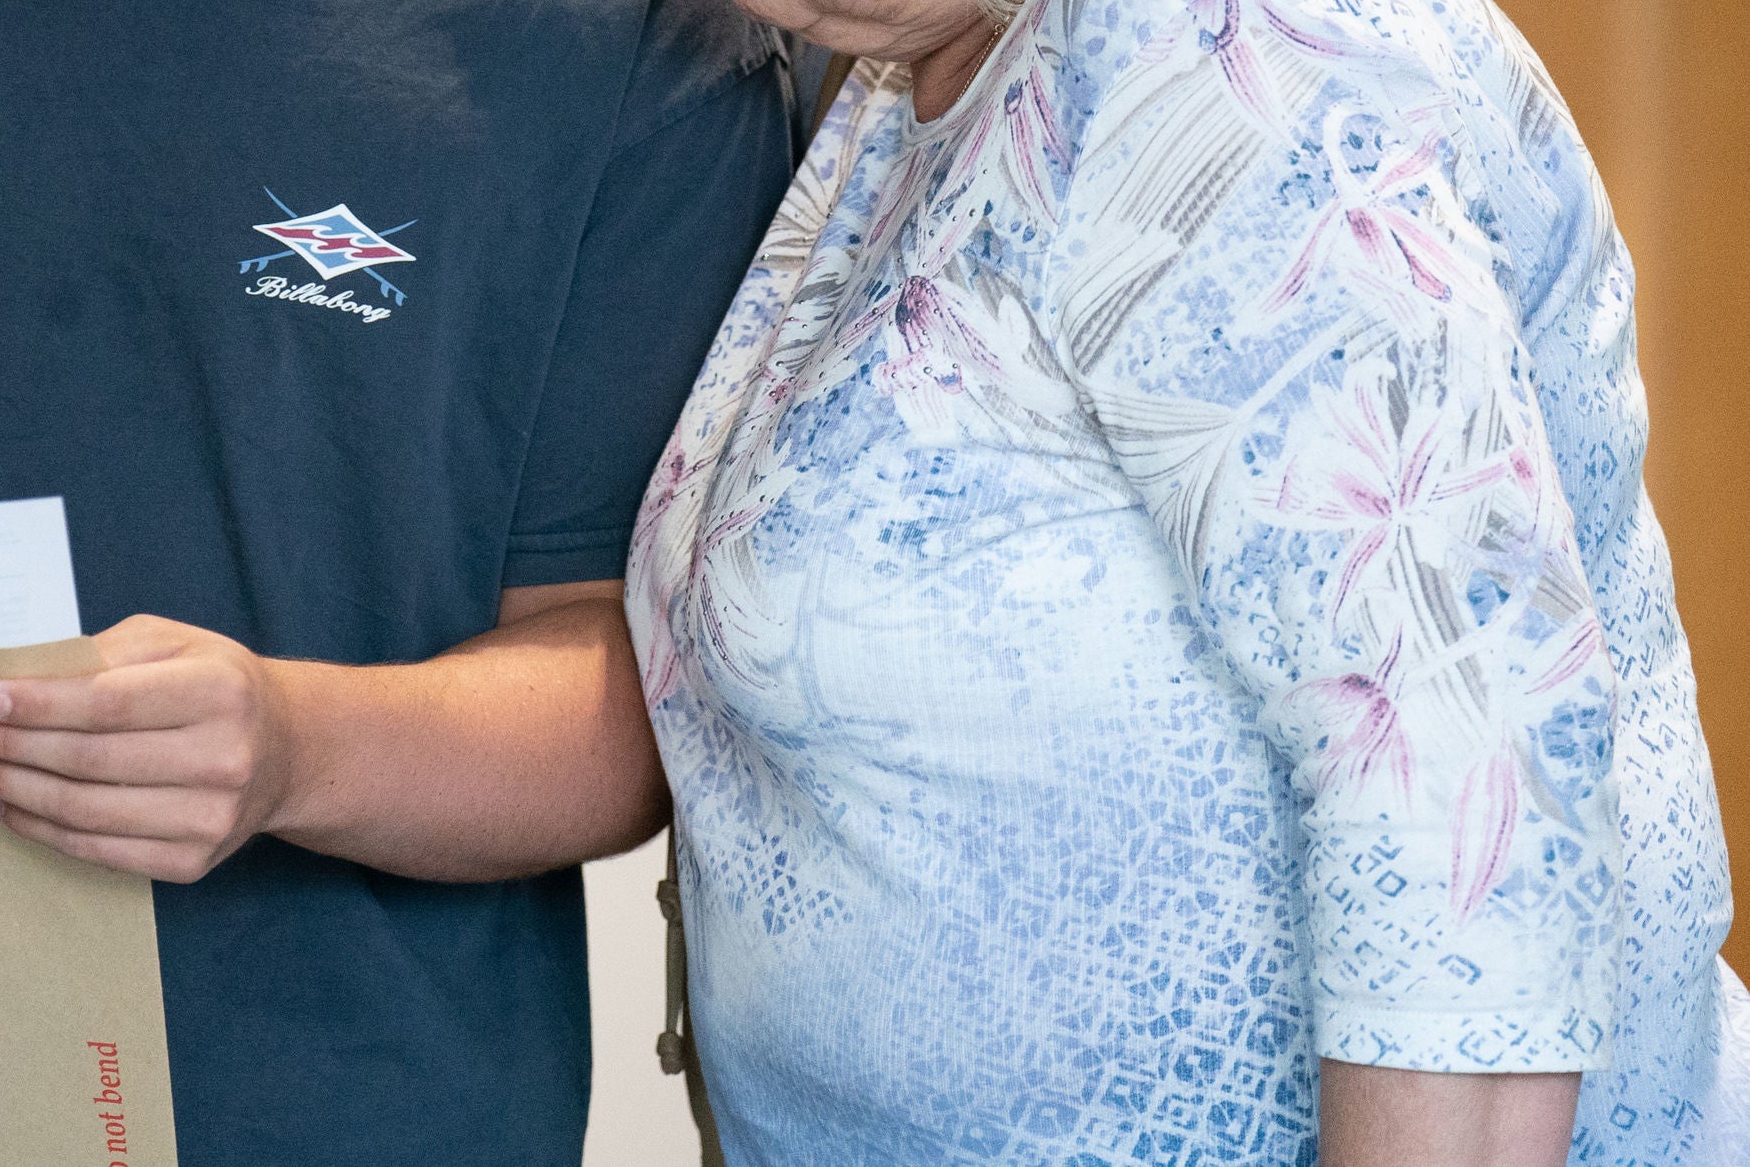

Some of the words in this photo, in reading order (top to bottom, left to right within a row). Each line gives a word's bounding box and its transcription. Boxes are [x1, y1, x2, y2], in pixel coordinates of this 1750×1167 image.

[245, 275, 392, 324] Billabong
[87, 1041, 123, 1105] bend
[98, 1112, 127, 1153] not
